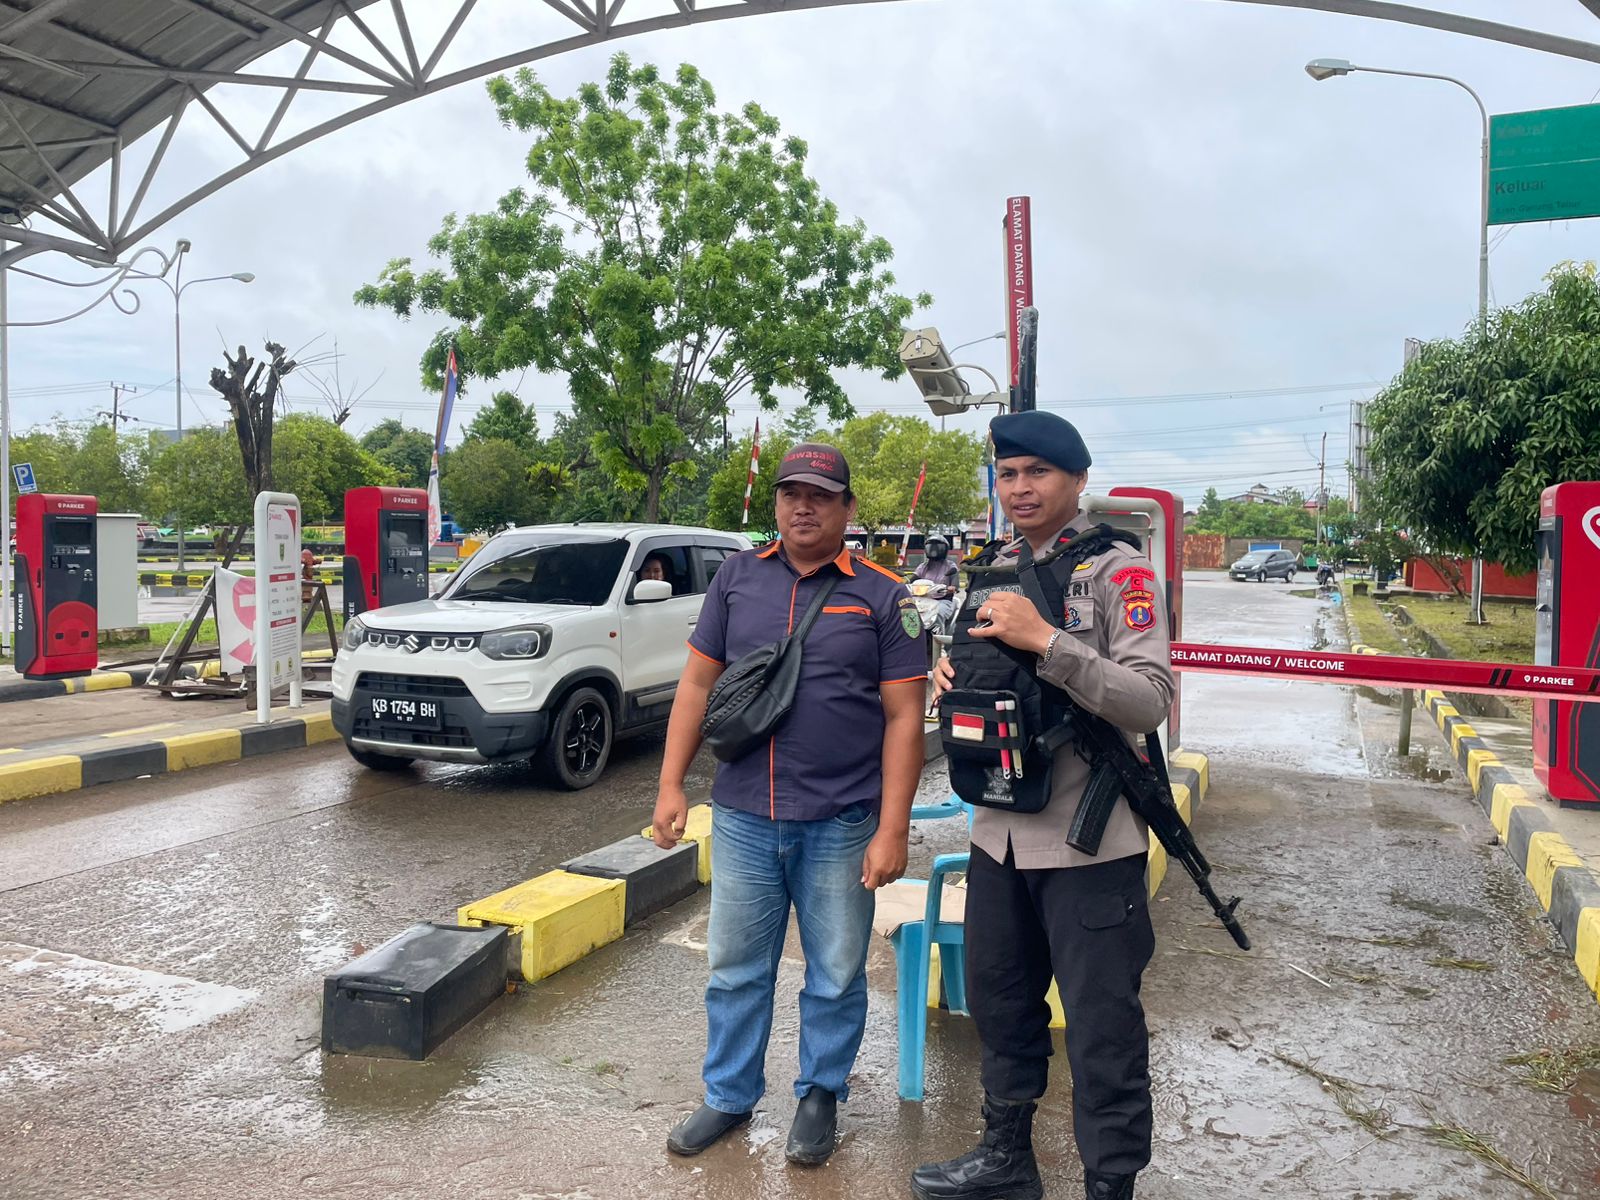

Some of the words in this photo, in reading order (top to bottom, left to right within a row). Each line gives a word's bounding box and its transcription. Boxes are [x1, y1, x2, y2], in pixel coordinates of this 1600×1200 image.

[1495, 180, 1546, 195] Keluar
[1014, 243, 1024, 287] DATANG
[810, 459, 833, 471] Ninja
[16, 467, 29, 485] P
[1133, 578, 1141, 586] C
[1170, 650, 1223, 663] SELAMAT
[1225, 654, 1272, 666] DATANG
[1274, 656, 1281, 668] /
[1285, 657, 1345, 671] WELCOME
[1533, 676, 1574, 686] PARKEE
[372, 698, 388, 713] KB
[389, 700, 416, 716] 1754
[420, 702, 436, 718] BH
